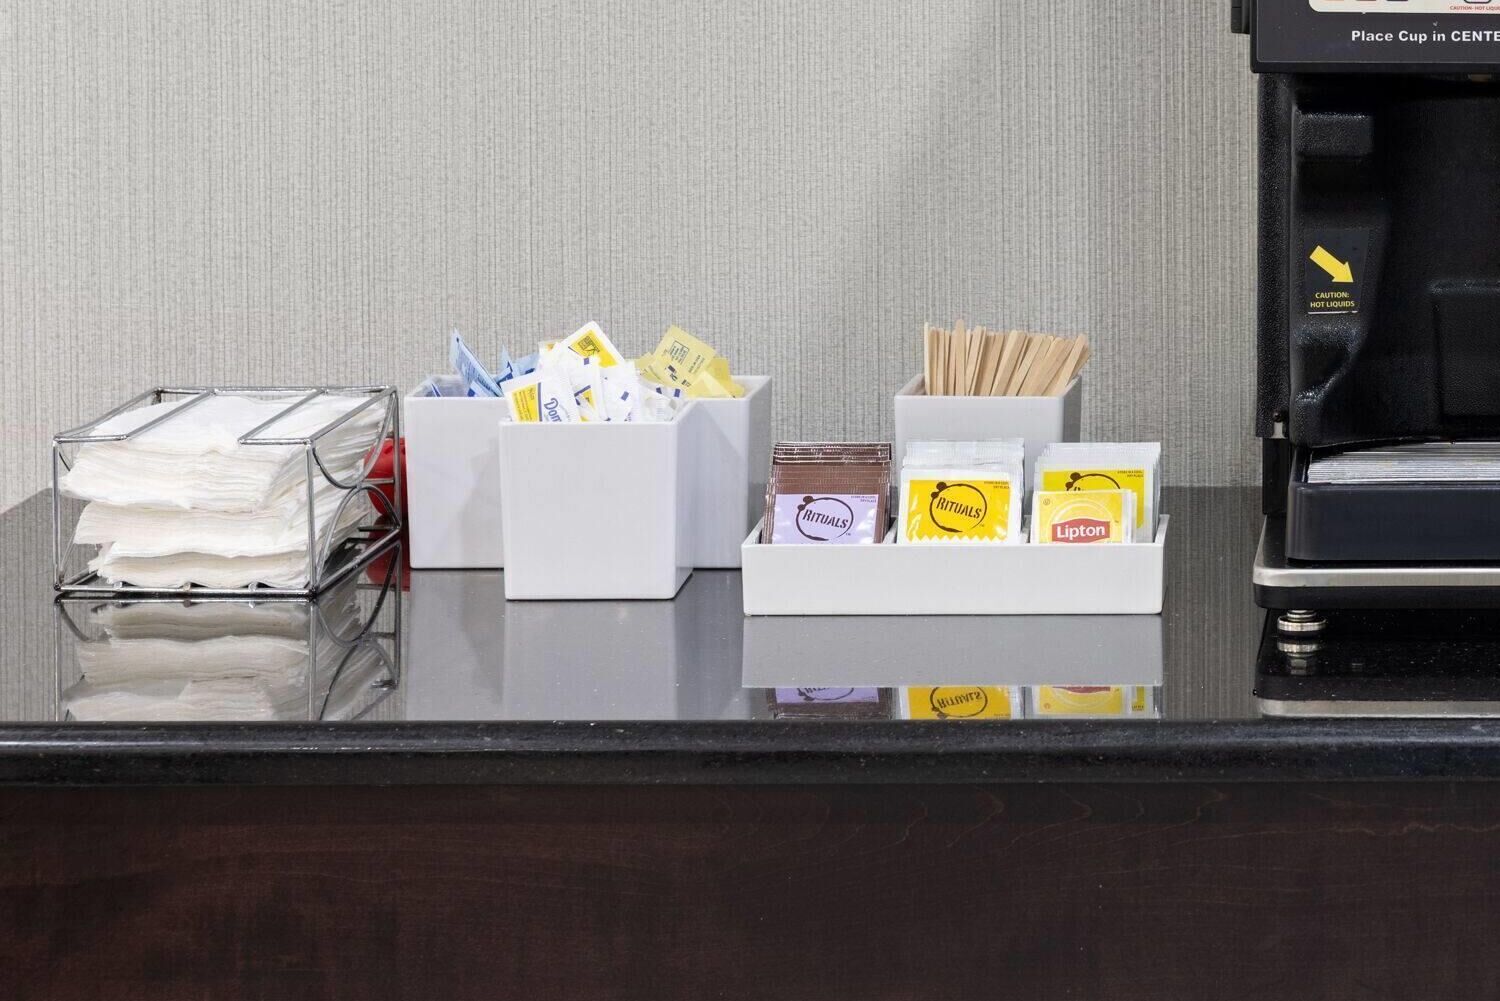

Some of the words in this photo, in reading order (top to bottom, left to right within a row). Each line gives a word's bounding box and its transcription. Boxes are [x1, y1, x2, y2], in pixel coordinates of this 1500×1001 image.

[1351, 30, 1393, 42] Place
[1398, 30, 1428, 43] Cup
[1432, 30, 1446, 42] in
[1326, 300, 1355, 308] LIQUIDS
[936, 497, 982, 519] RITUALS
[802, 509, 849, 529] RITUALS
[1057, 525, 1105, 540] Lipton
